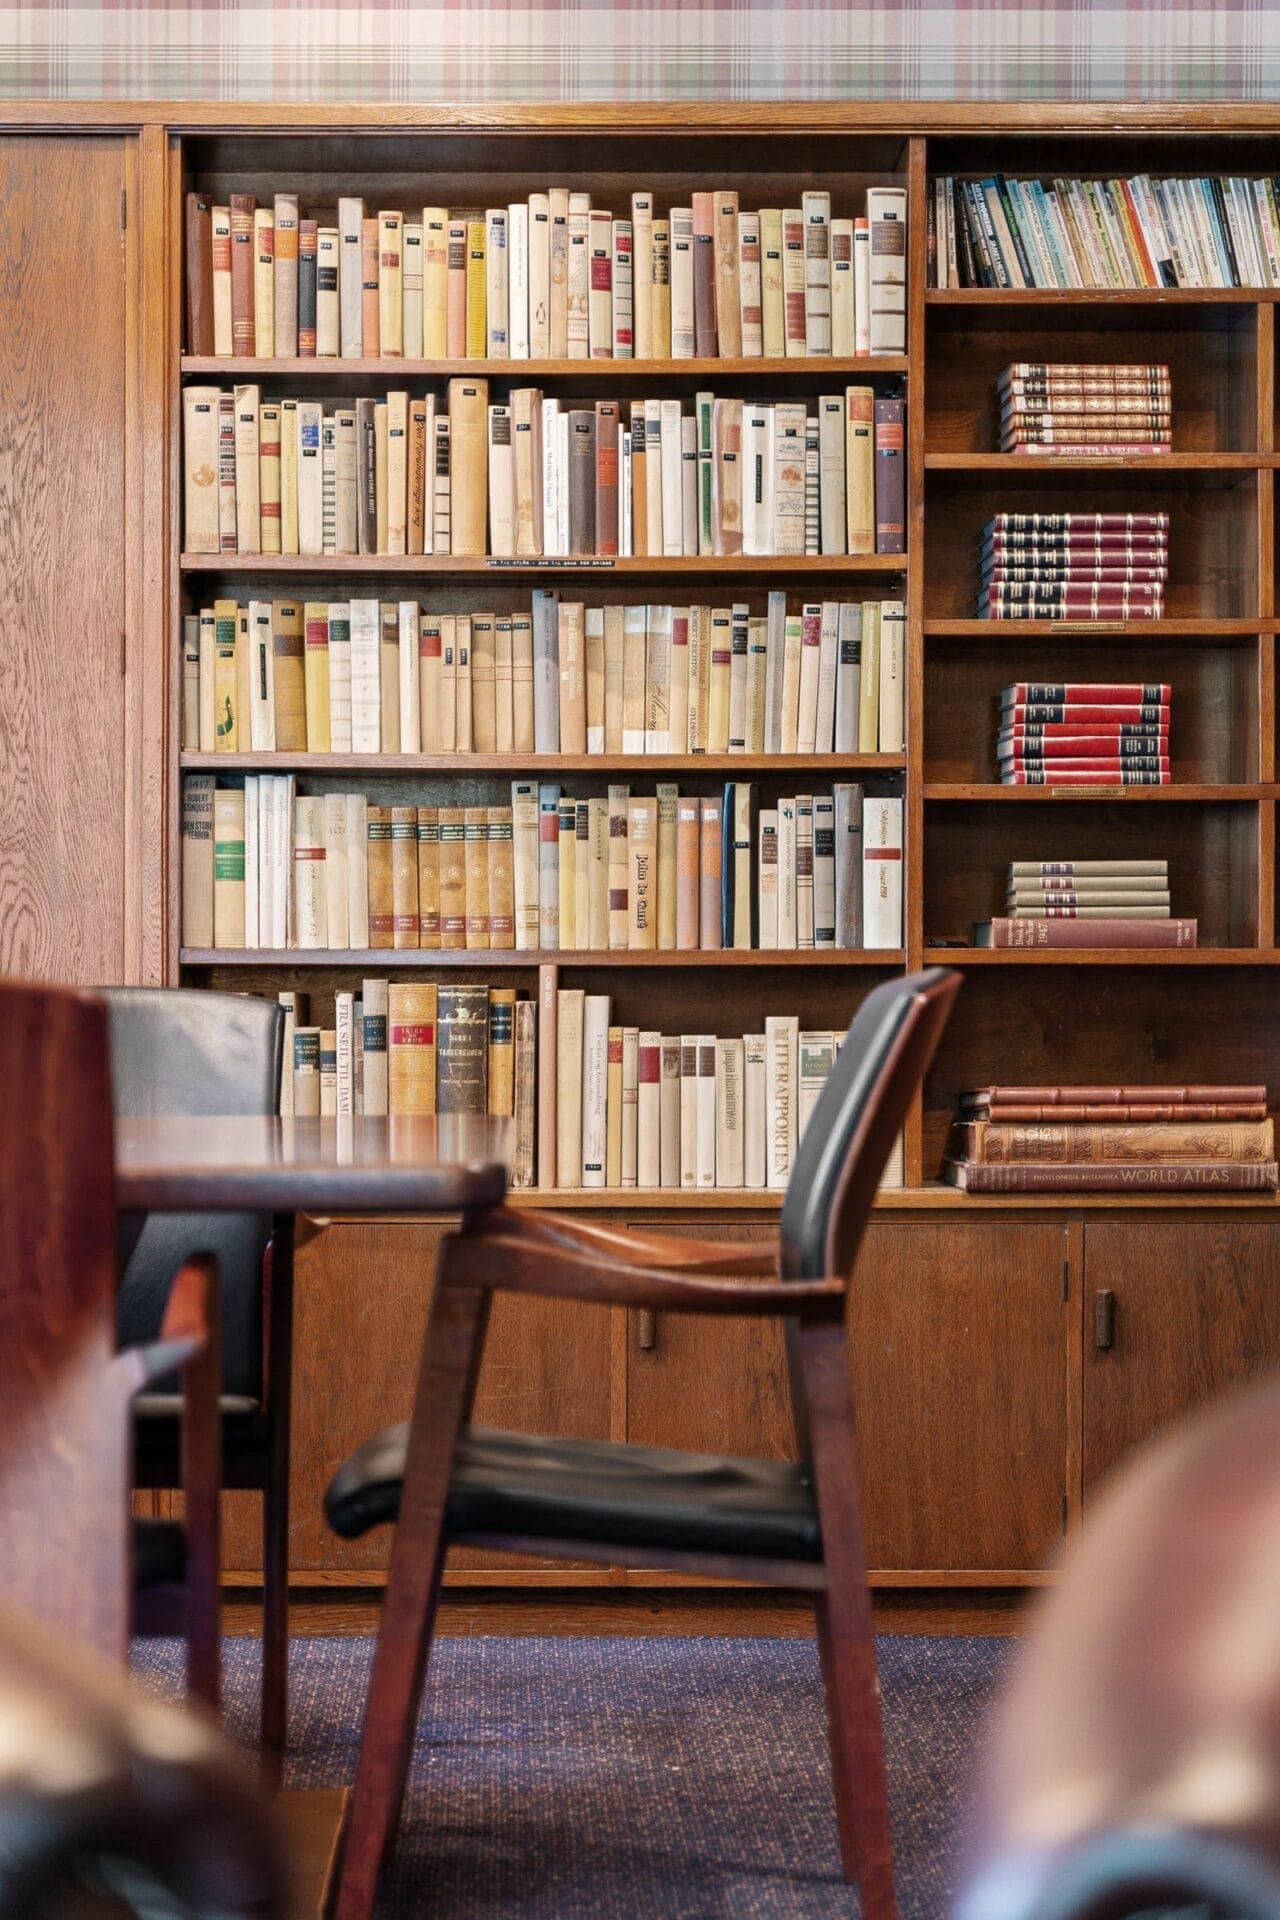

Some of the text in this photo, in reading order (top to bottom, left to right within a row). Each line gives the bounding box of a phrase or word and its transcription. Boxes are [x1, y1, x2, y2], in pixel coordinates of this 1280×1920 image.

[974, 183, 983, 202] LOST
[978, 202, 993, 236] HORIZON
[991, 240, 1001, 261] JAMES
[995, 261, 1007, 284] HILTON
[187, 794, 209, 802] ROBERT
[184, 803, 213, 814] CONQUEST
[636, 854, 649, 880] John
[638, 883, 648, 895] le
[1015, 929, 1024, 946] Book
[1026, 919, 1034, 945] the Year
[1038, 923, 1048, 943] 1947
[339, 1004, 348, 1029] FRA
[338, 1032, 348, 1060] SEIL
[339, 1062, 348, 1082] TIL
[722, 1050, 736, 1074] papa
[1120, 1170, 1178, 1184] WORLD
[1184, 1170, 1230, 1184] ATLAS
